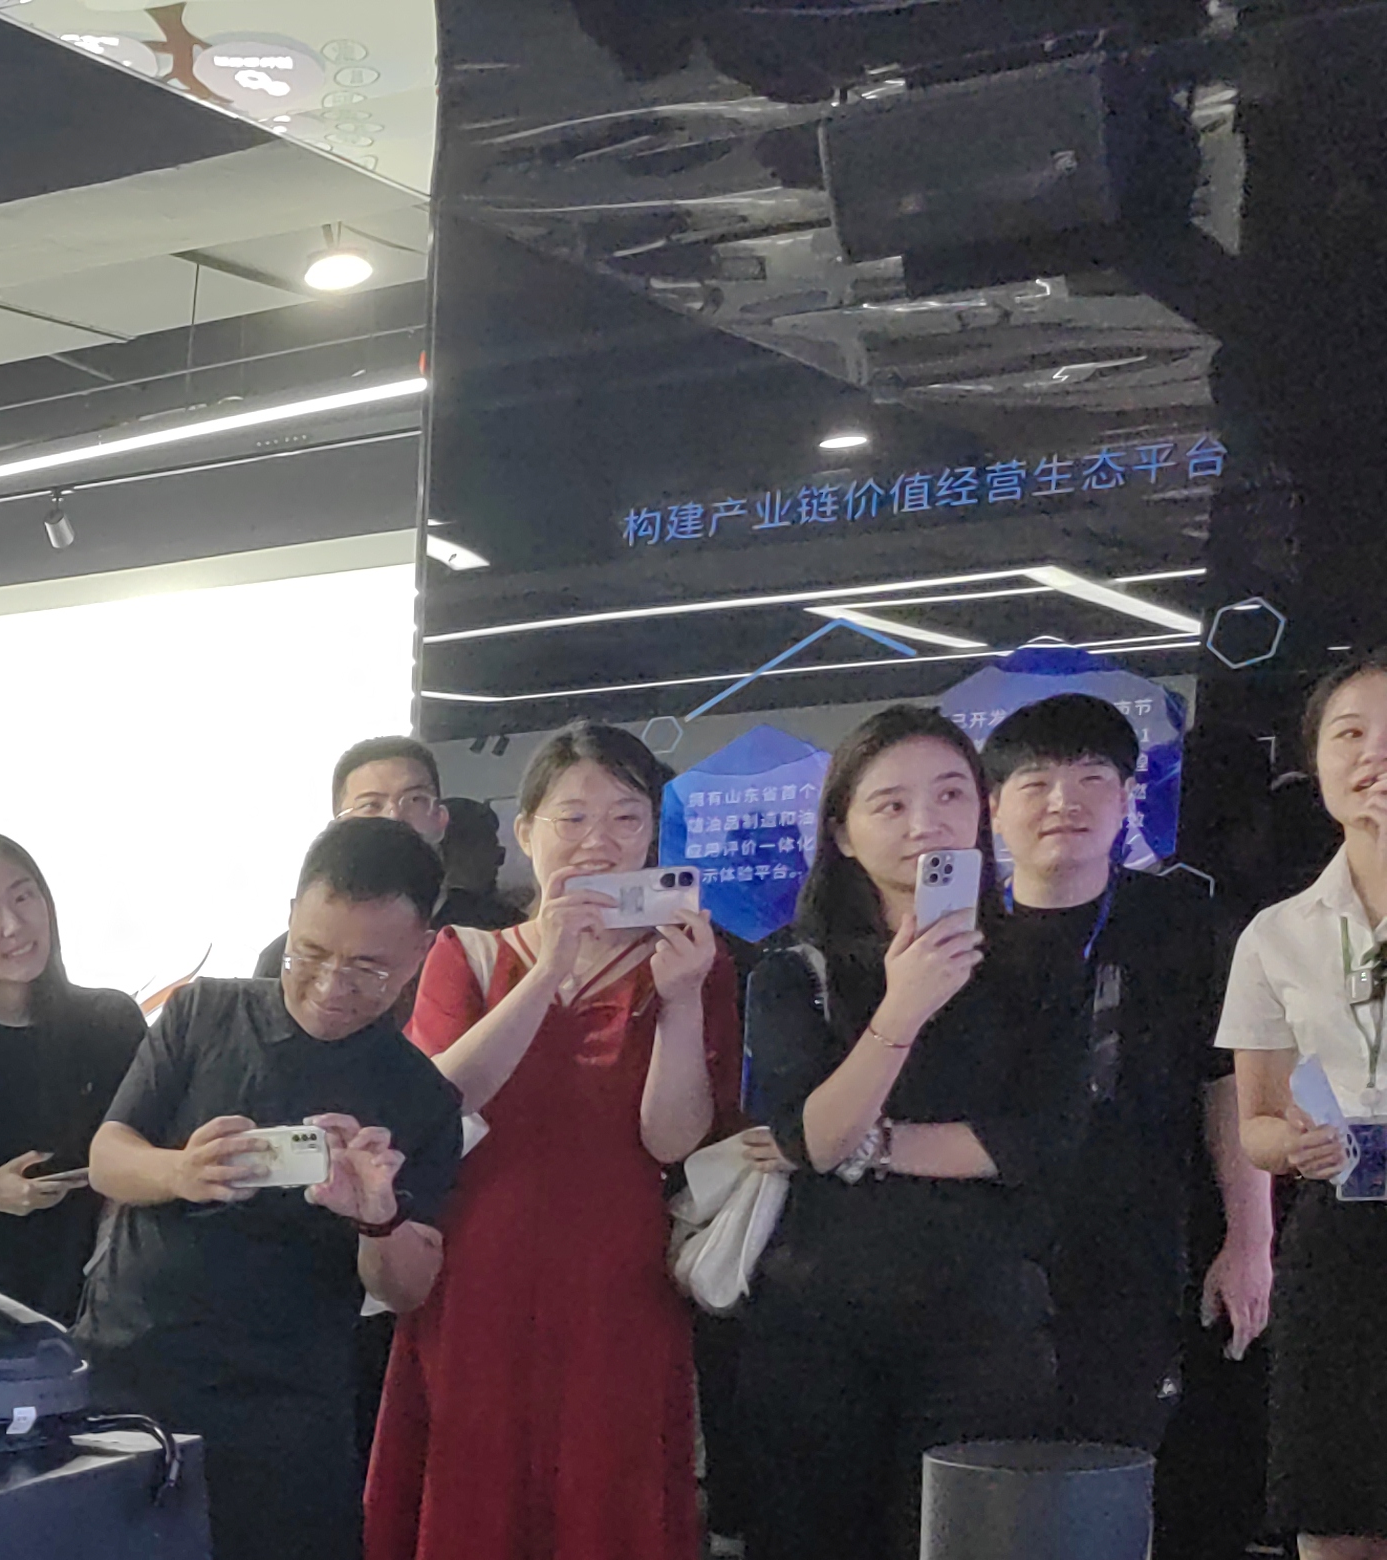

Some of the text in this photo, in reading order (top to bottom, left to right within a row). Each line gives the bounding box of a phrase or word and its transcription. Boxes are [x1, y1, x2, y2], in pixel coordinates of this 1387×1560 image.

[623, 437, 1228, 547] 构建产业链价值经营生态平台
[688, 783, 817, 808] 拥有山东省首个
[685, 836, 815, 859] 应用评价一体化
